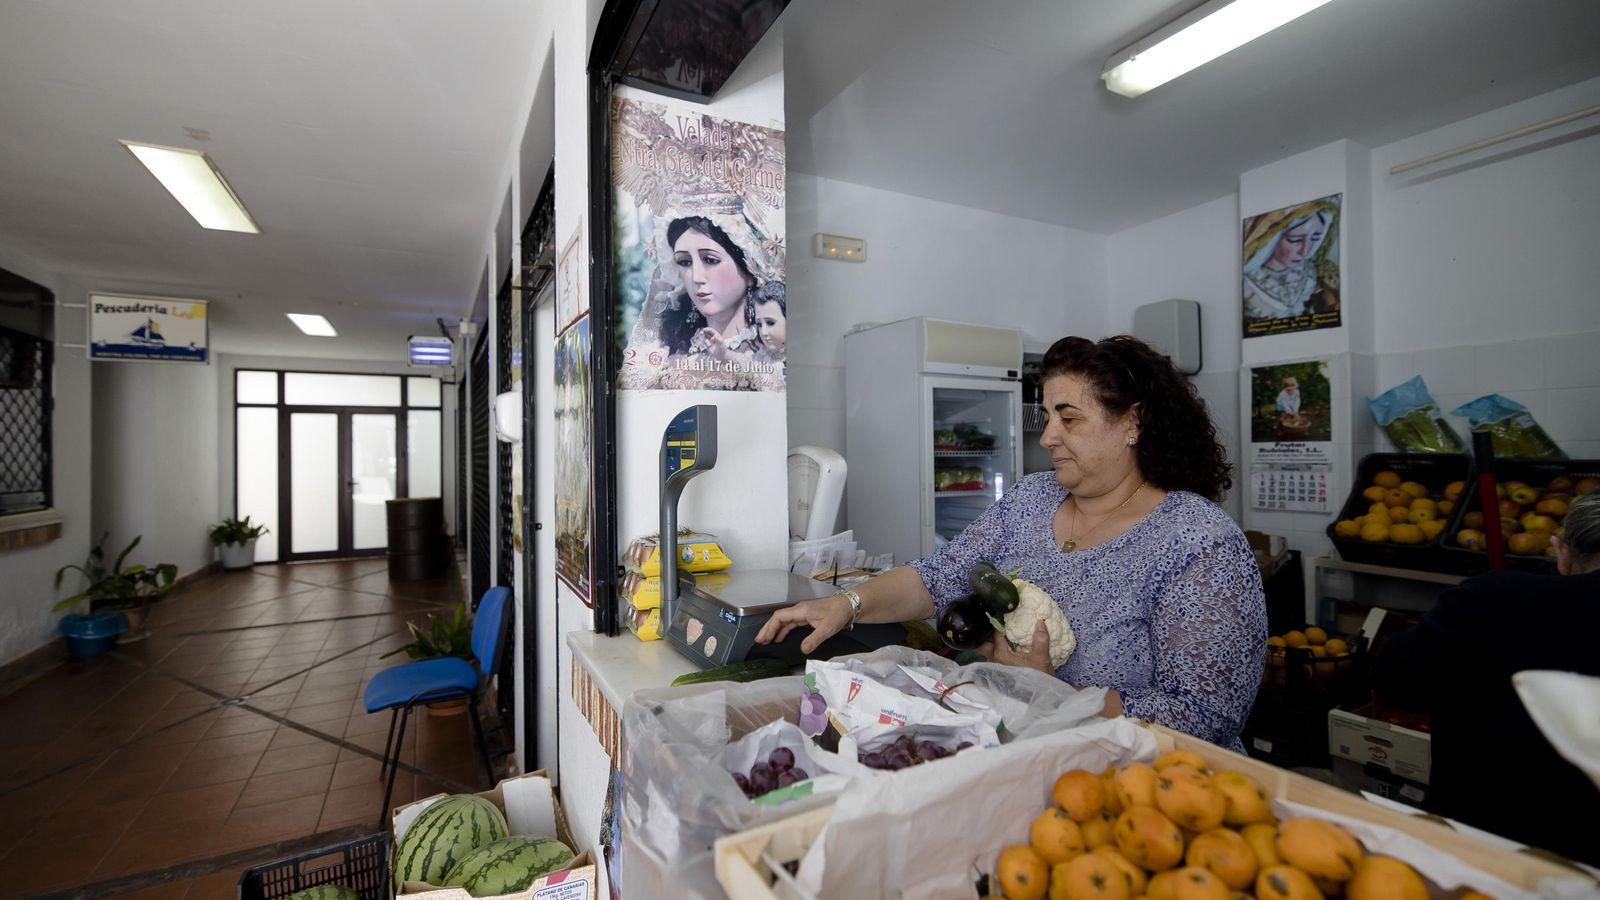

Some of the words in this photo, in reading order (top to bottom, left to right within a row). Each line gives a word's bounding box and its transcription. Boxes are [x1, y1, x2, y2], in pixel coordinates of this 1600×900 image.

[675, 115, 732, 151] Velada
[617, 136, 663, 170] Ntra.
[665, 145, 699, 177] Sra.
[702, 152, 728, 181] del
[675, 358, 689, 371] 14
[694, 359, 705, 371] al
[709, 360, 722, 372] 17
[725, 360, 740, 372] de
[743, 361, 775, 374] Julio
